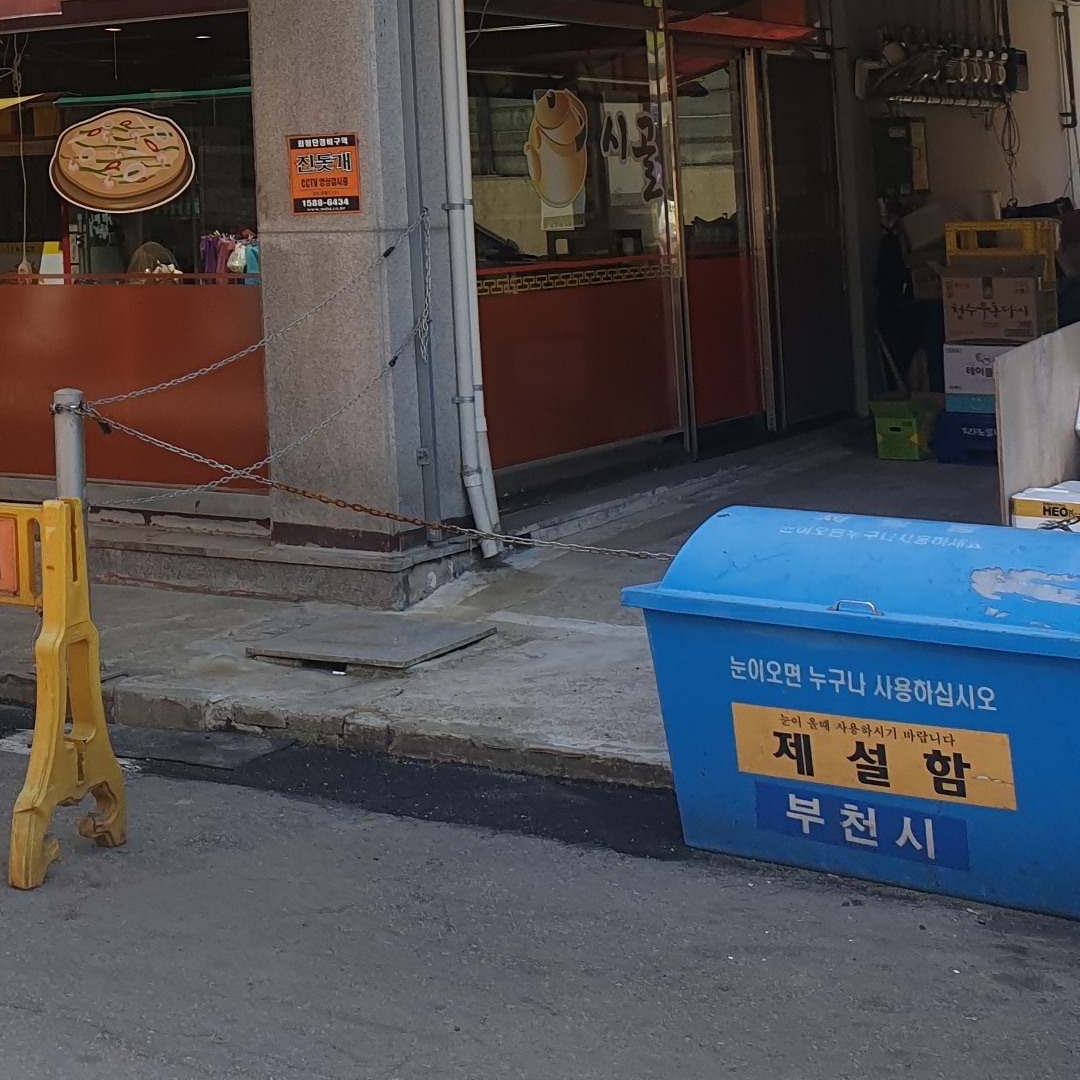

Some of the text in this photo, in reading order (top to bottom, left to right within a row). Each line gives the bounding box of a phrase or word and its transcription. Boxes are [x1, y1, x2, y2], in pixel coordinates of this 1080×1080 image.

[295, 151, 352, 174] 진돗개
[600, 110, 664, 205] 시골
[301, 179, 318, 188] CCTV
[730, 656, 998, 711] 눈이오면 누구나 사용하십시오
[779, 713, 803, 728] 눈이
[835, 722, 898, 740] 사용하시기
[903, 728, 956, 747] 바랍니다
